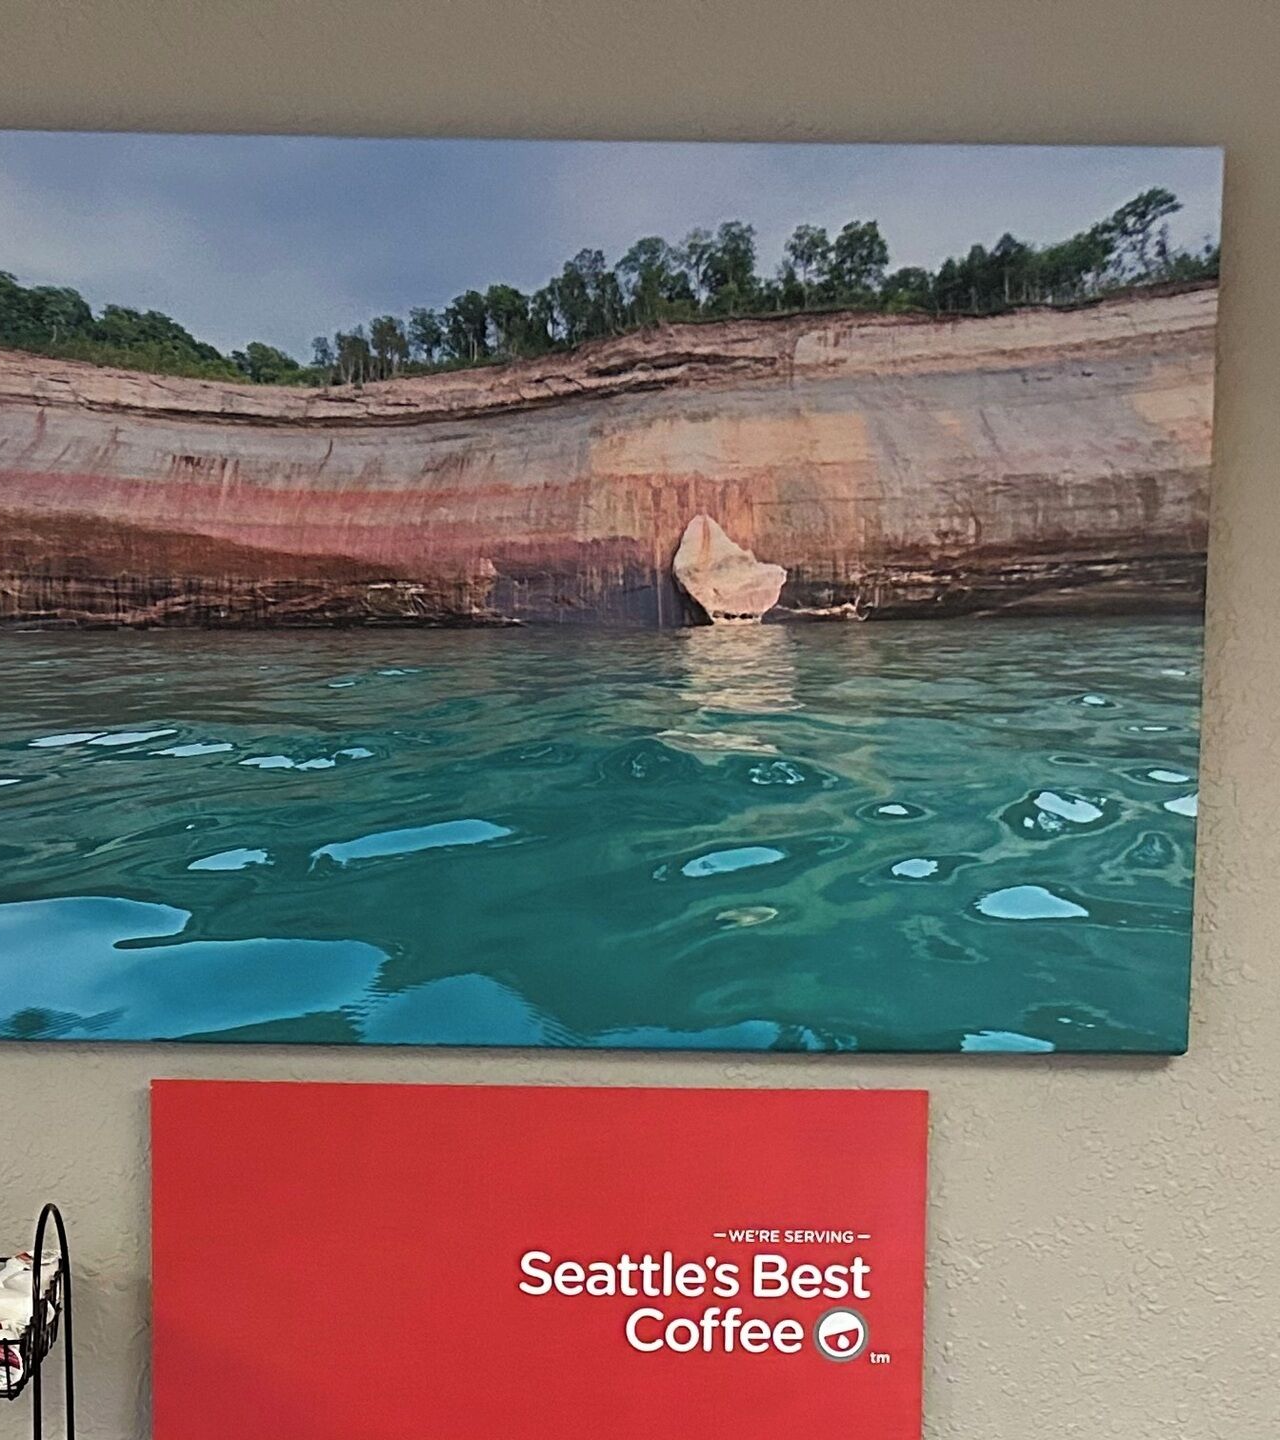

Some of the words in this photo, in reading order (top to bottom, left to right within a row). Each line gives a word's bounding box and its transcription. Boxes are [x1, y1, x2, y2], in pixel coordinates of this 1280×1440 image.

[729, 1229, 780, 1243] WE'RE
[784, 1230, 854, 1244] SERVING
[519, 1251, 739, 1297] Seattle's
[754, 1254, 871, 1298] Best
[625, 1307, 803, 1353] Coffee
